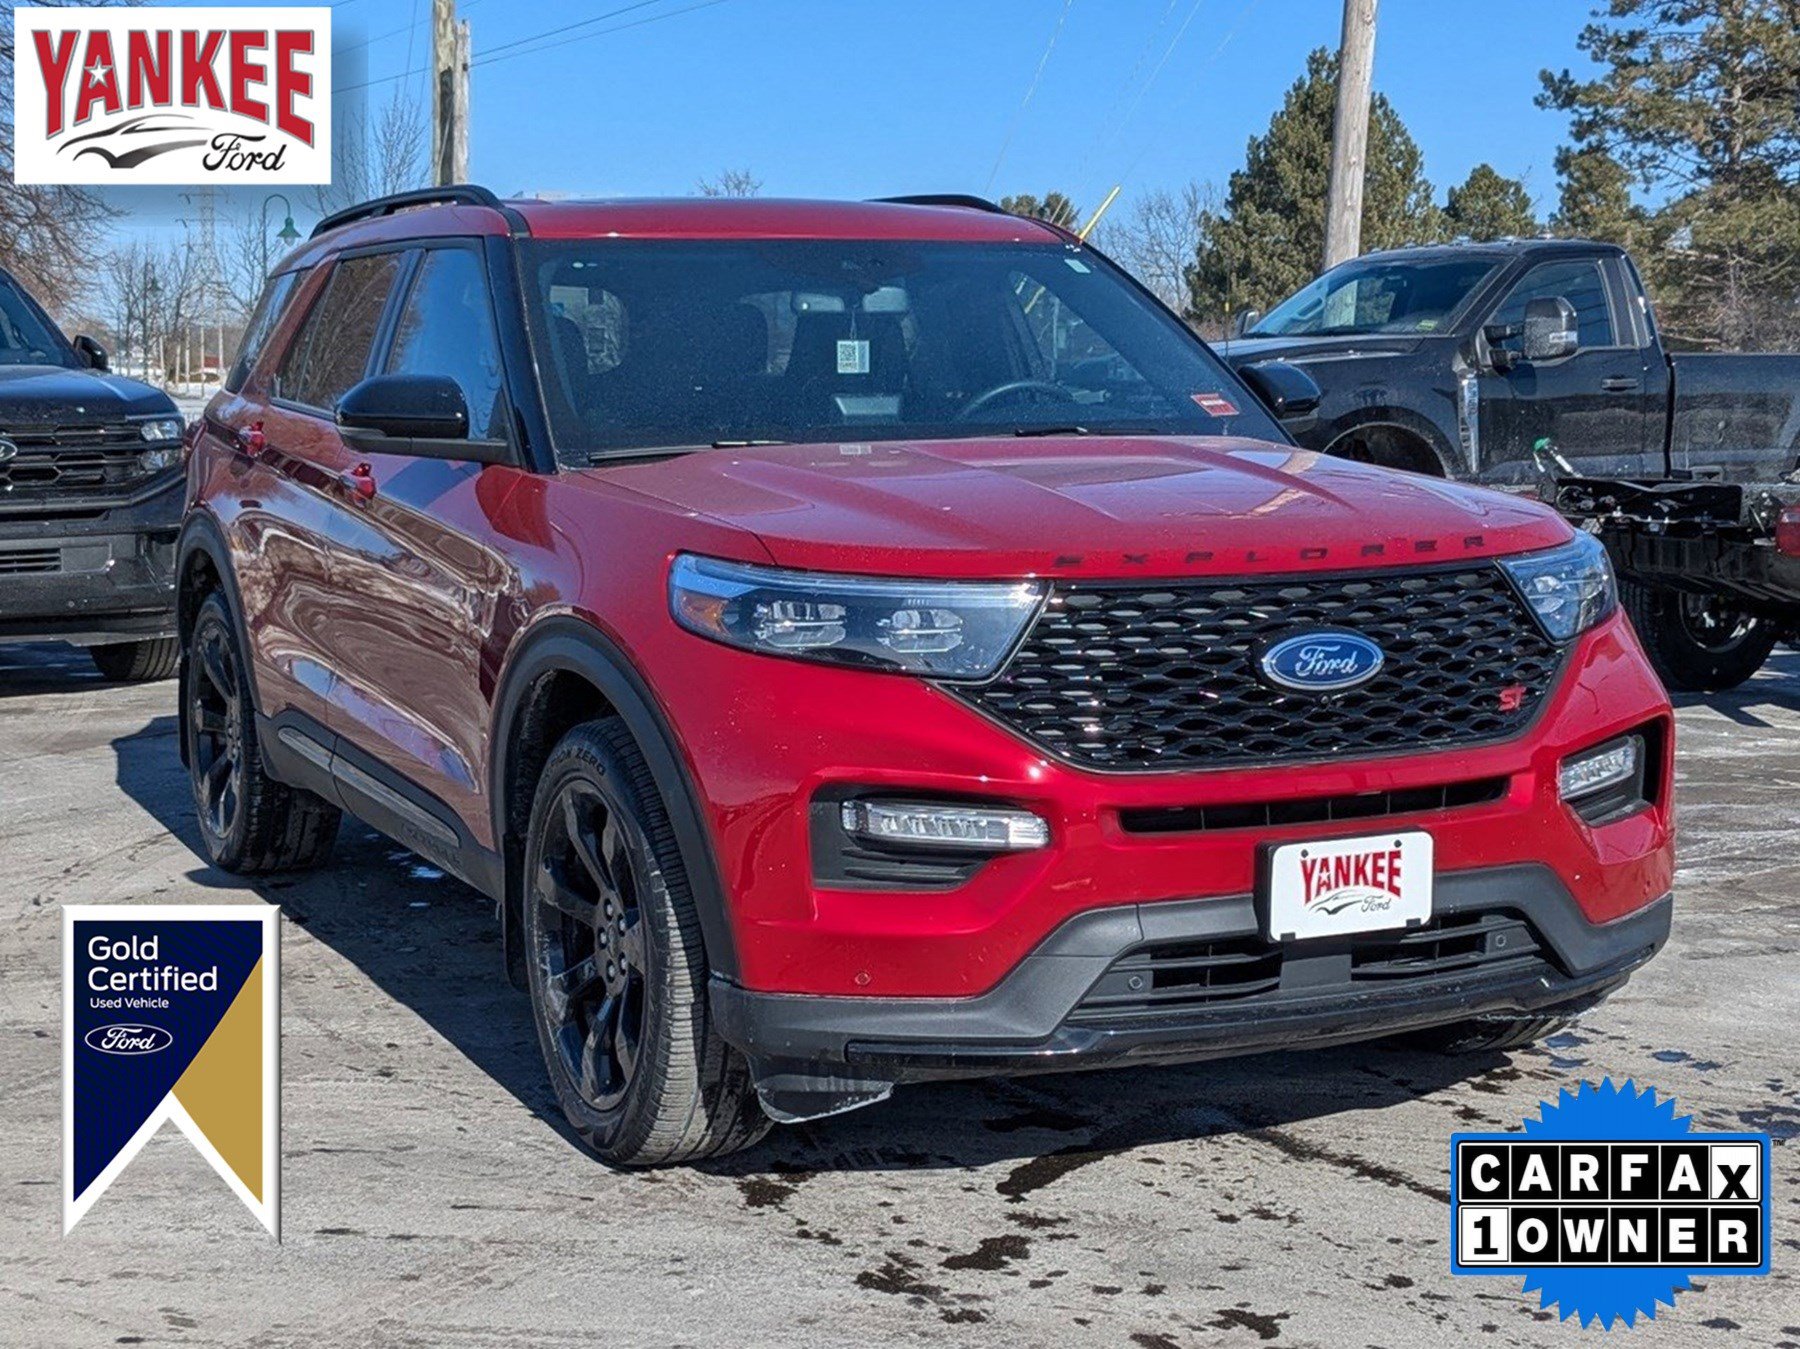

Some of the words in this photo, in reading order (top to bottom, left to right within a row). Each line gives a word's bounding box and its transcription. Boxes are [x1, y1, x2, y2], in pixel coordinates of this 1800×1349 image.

[1055, 535, 1484, 566] EXPLORER
[1295, 645, 1358, 677] Ford
[1499, 685, 1526, 711] ST
[1300, 850, 1402, 905] YANKEE
[1361, 895, 1392, 912] Ford
